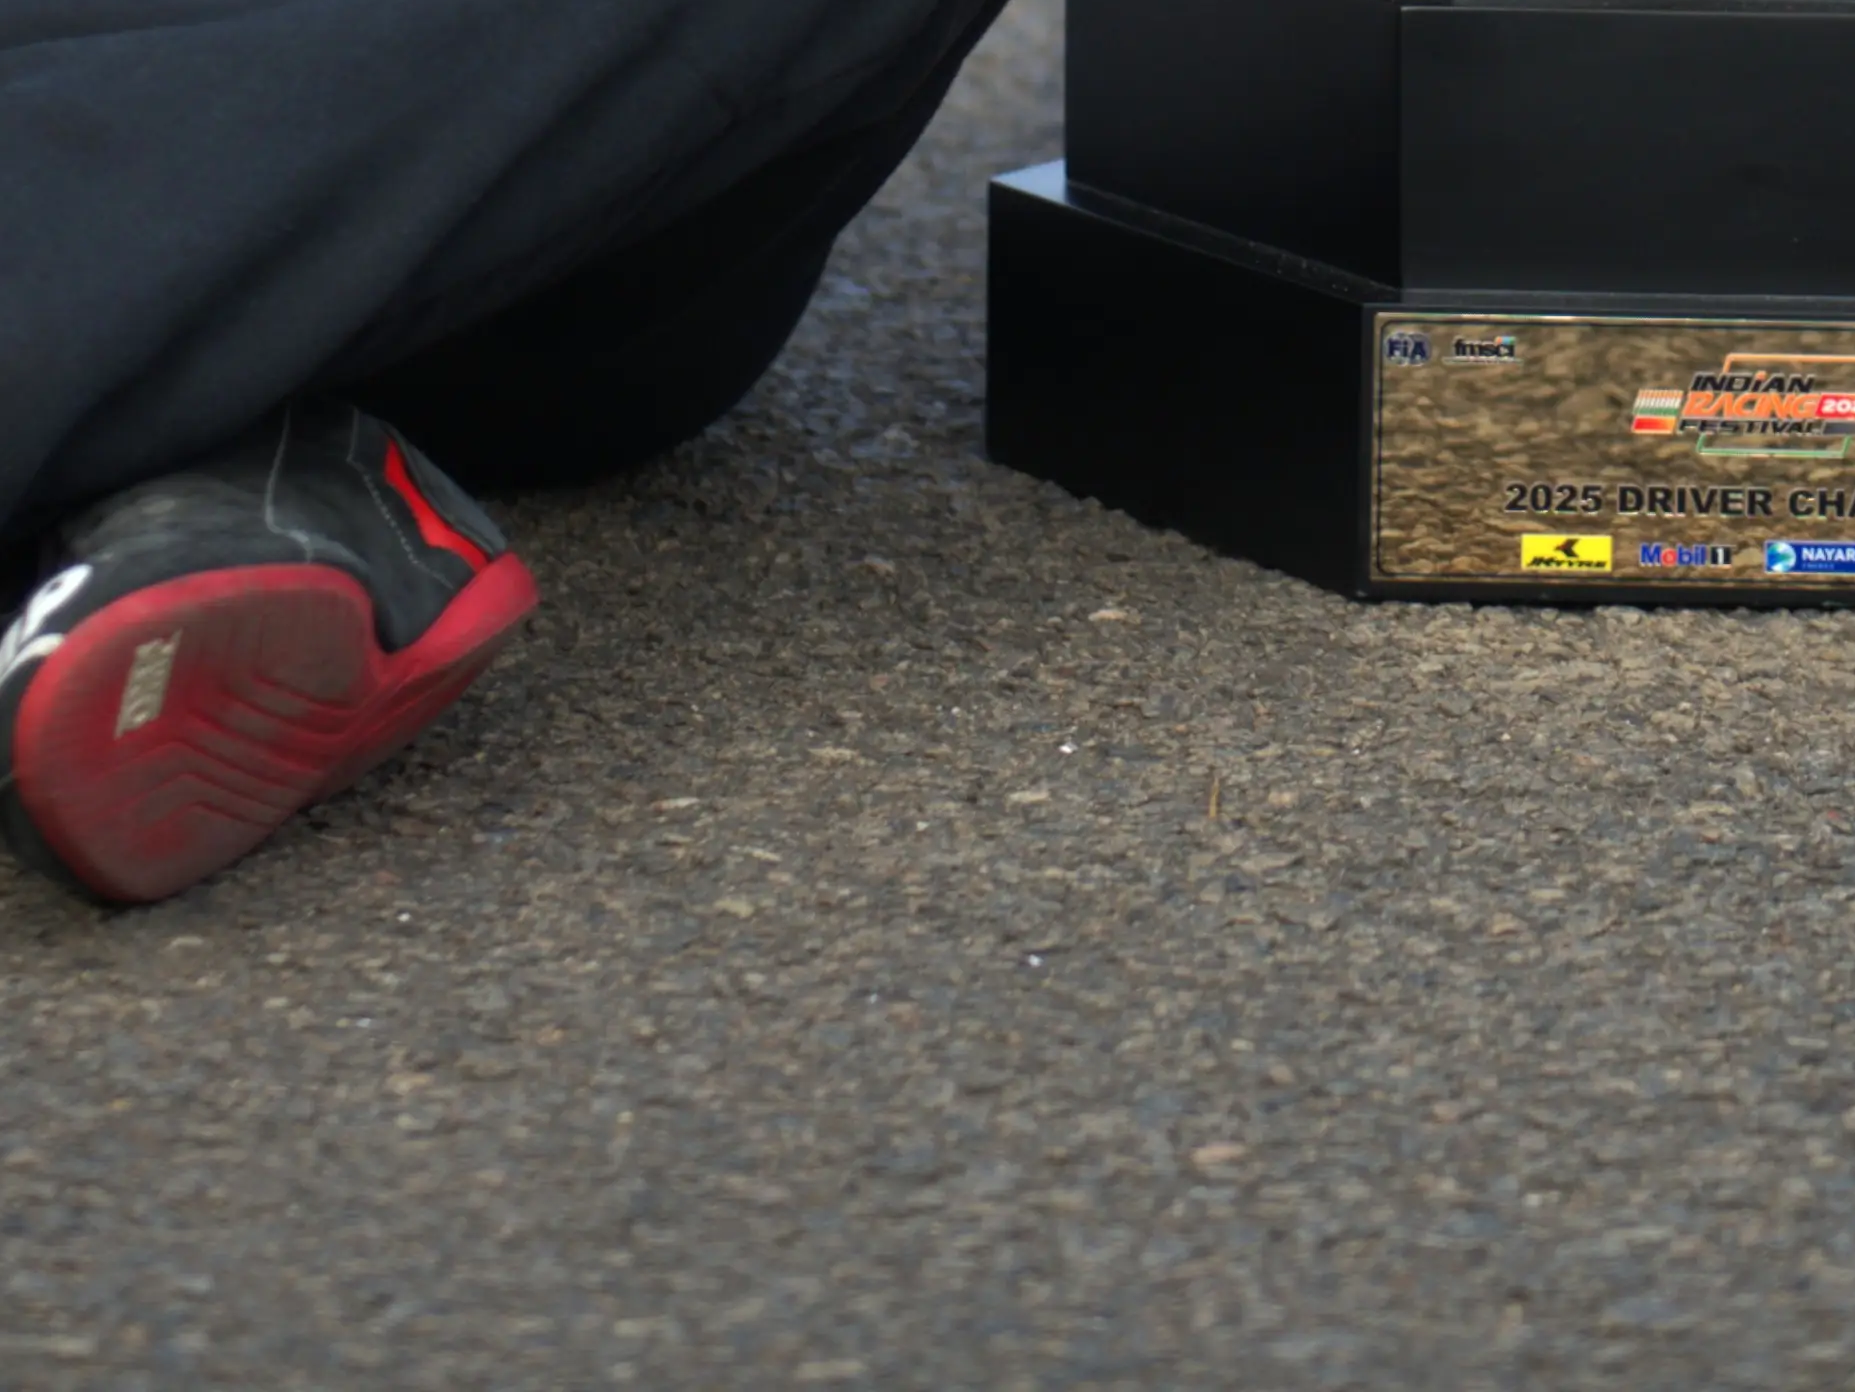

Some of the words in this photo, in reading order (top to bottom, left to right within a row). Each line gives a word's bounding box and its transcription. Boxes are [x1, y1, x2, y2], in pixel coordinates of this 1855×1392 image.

[1681, 391, 1821, 420] RACING
[1677, 419, 1823, 434] FESTIVAL
[1504, 484, 1603, 513] 2025
[1618, 486, 1773, 515] DRIVER
[1640, 544, 1707, 566] Mobil
